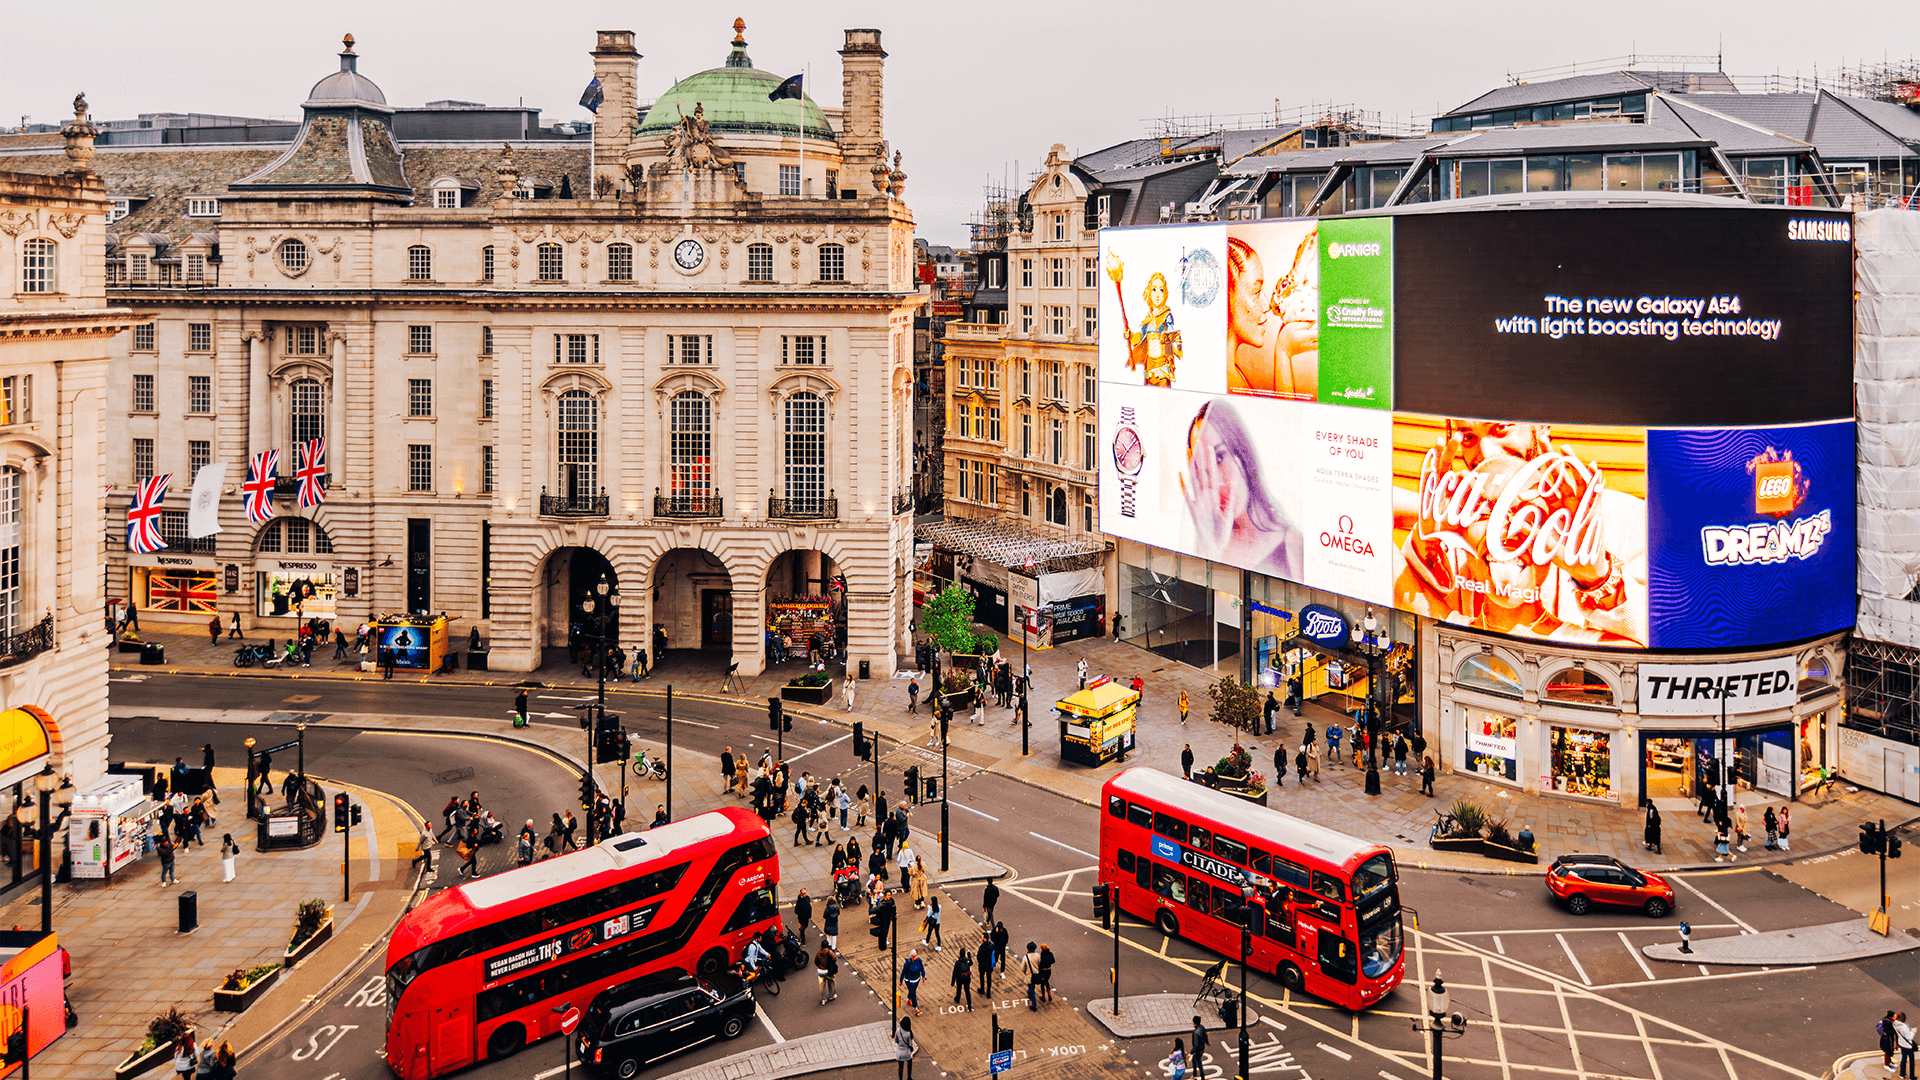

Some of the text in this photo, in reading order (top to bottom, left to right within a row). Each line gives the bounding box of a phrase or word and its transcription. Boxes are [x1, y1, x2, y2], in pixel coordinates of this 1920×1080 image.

[1788, 218, 1851, 242] SAMSUNG
[1342, 306, 1384, 318] Cruelty Free
[1545, 295, 1741, 319] The new Galaxy A54
[1495, 315, 1781, 341] with light boosting technology
[1316, 430, 1378, 448] EVERY SHADE
[1329, 446, 1364, 460] OF YOU
[1316, 467, 1379, 484] AQUA TERRA SHADES
[1758, 476, 1792, 498] LEGO
[1320, 531, 1375, 558] OMEGA
[157, 556, 193, 566] NESPRESSO
[278, 560, 317, 570] NESPRESSO
[1455, 575, 1552, 604] Real Magic
[1056, 614, 1087, 625] AVAILABLE
[1251, 601, 1292, 622] pharmacy
[1303, 611, 1343, 639] Boots
[1647, 669, 1795, 700] THRIFTED.
[1475, 740, 1508, 752] THRIFTED.
[1842, 740, 1858, 749] 2023
[1159, 842, 1173, 853] prime
[1183, 851, 1238, 880] CITADE
[747, 873, 765, 882] ARRIVA
[490, 949, 537, 970] VEGAN BACON HAS
[490, 955, 539, 977] NEVER LOOKED LIKE
[992, 998, 1030, 1010] LEFT
[291, 1025, 360, 1061] ST
[1047, 1044, 1086, 1057] LOOK
